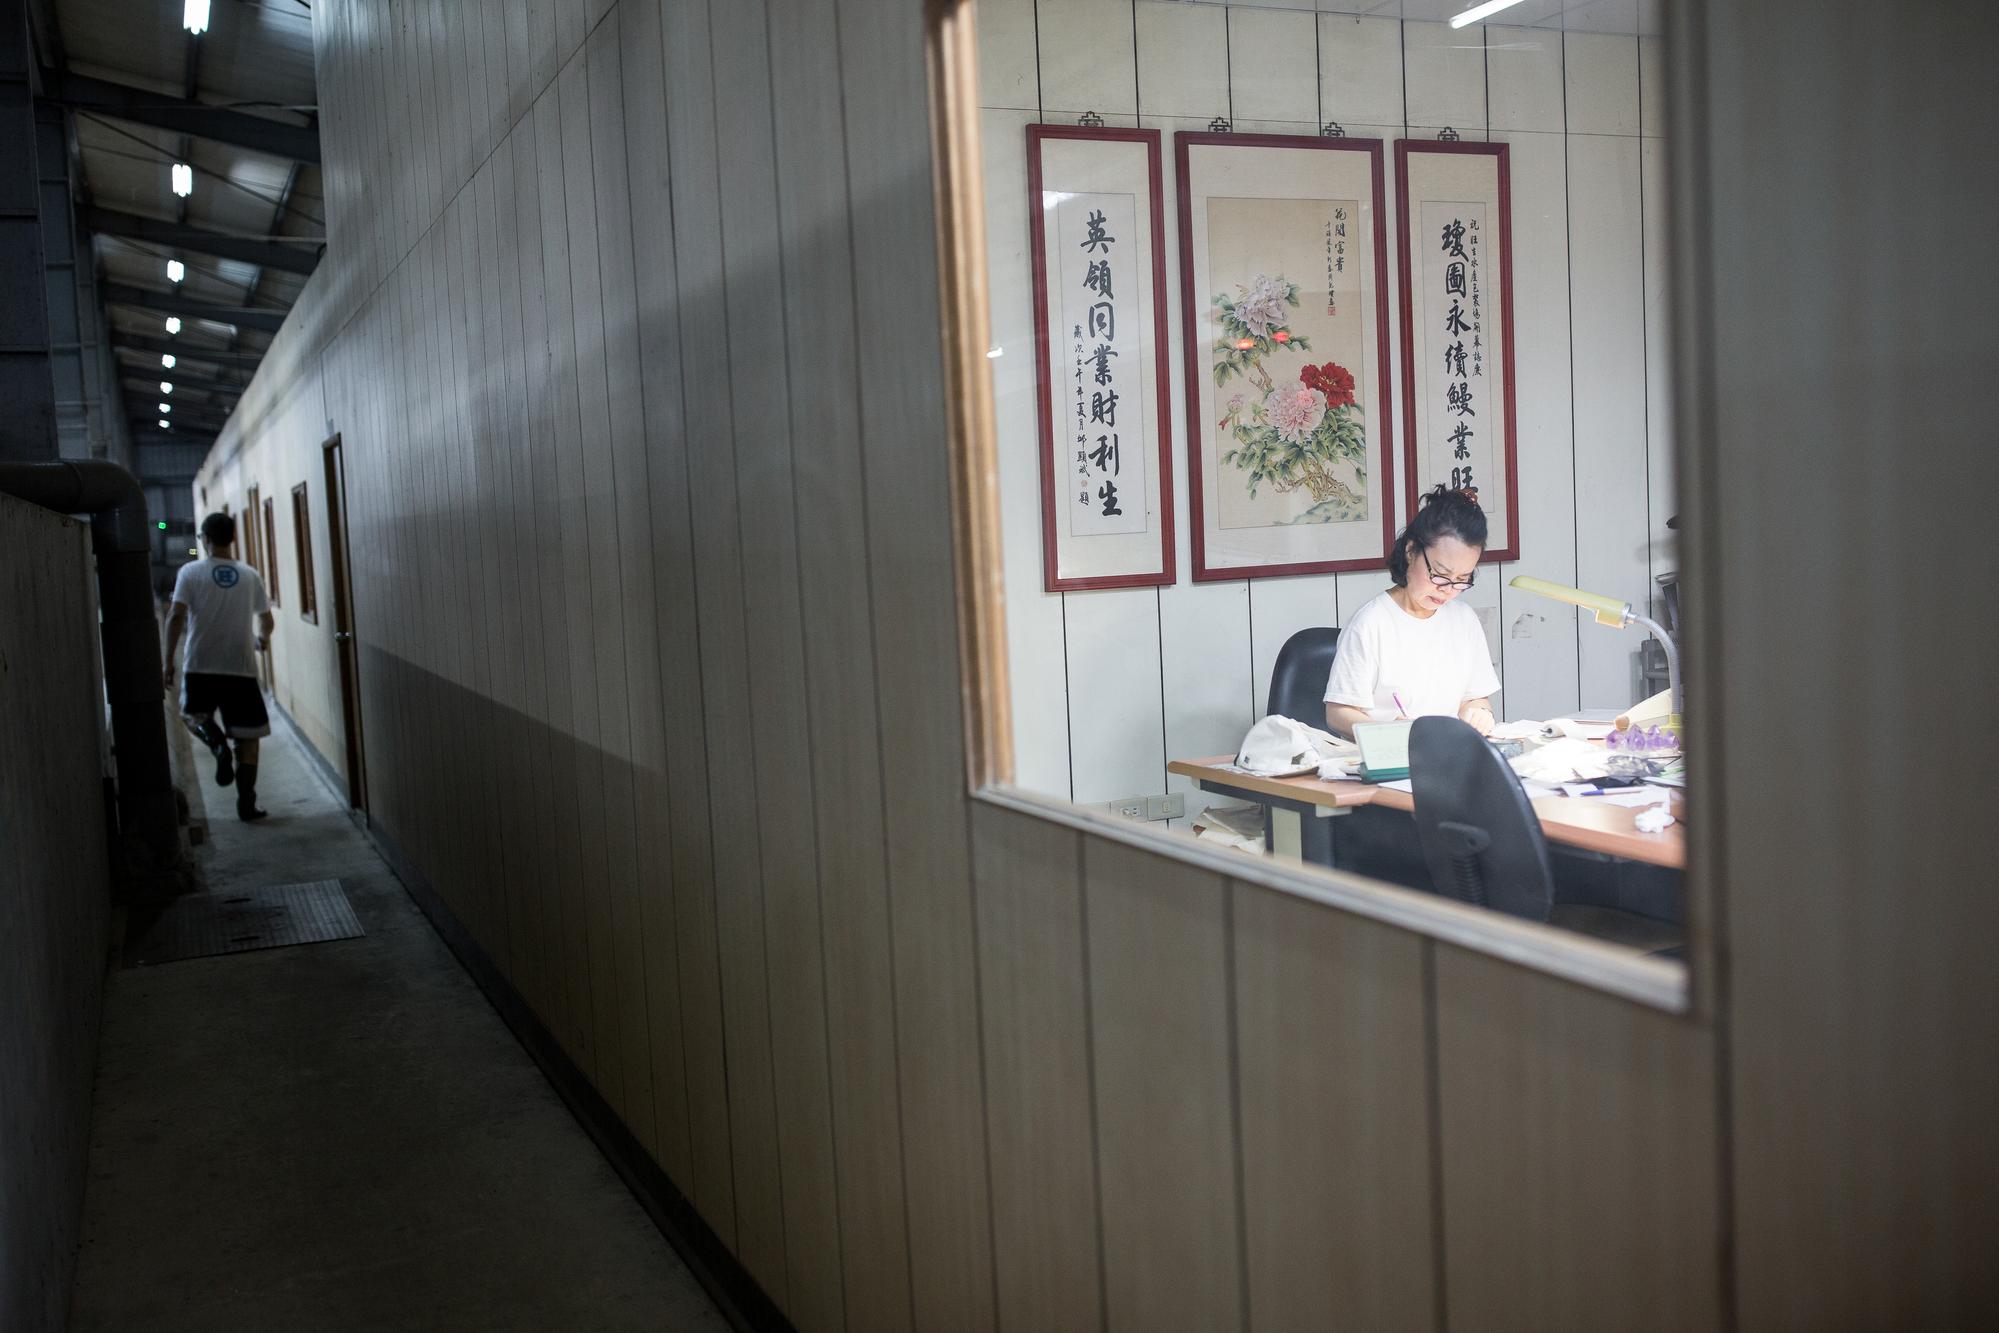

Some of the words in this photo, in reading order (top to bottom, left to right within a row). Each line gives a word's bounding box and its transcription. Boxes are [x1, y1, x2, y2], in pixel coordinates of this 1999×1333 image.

[1335, 207, 1346, 273] 花開富貴
[1080, 209, 1122, 516] 英領同業財利生
